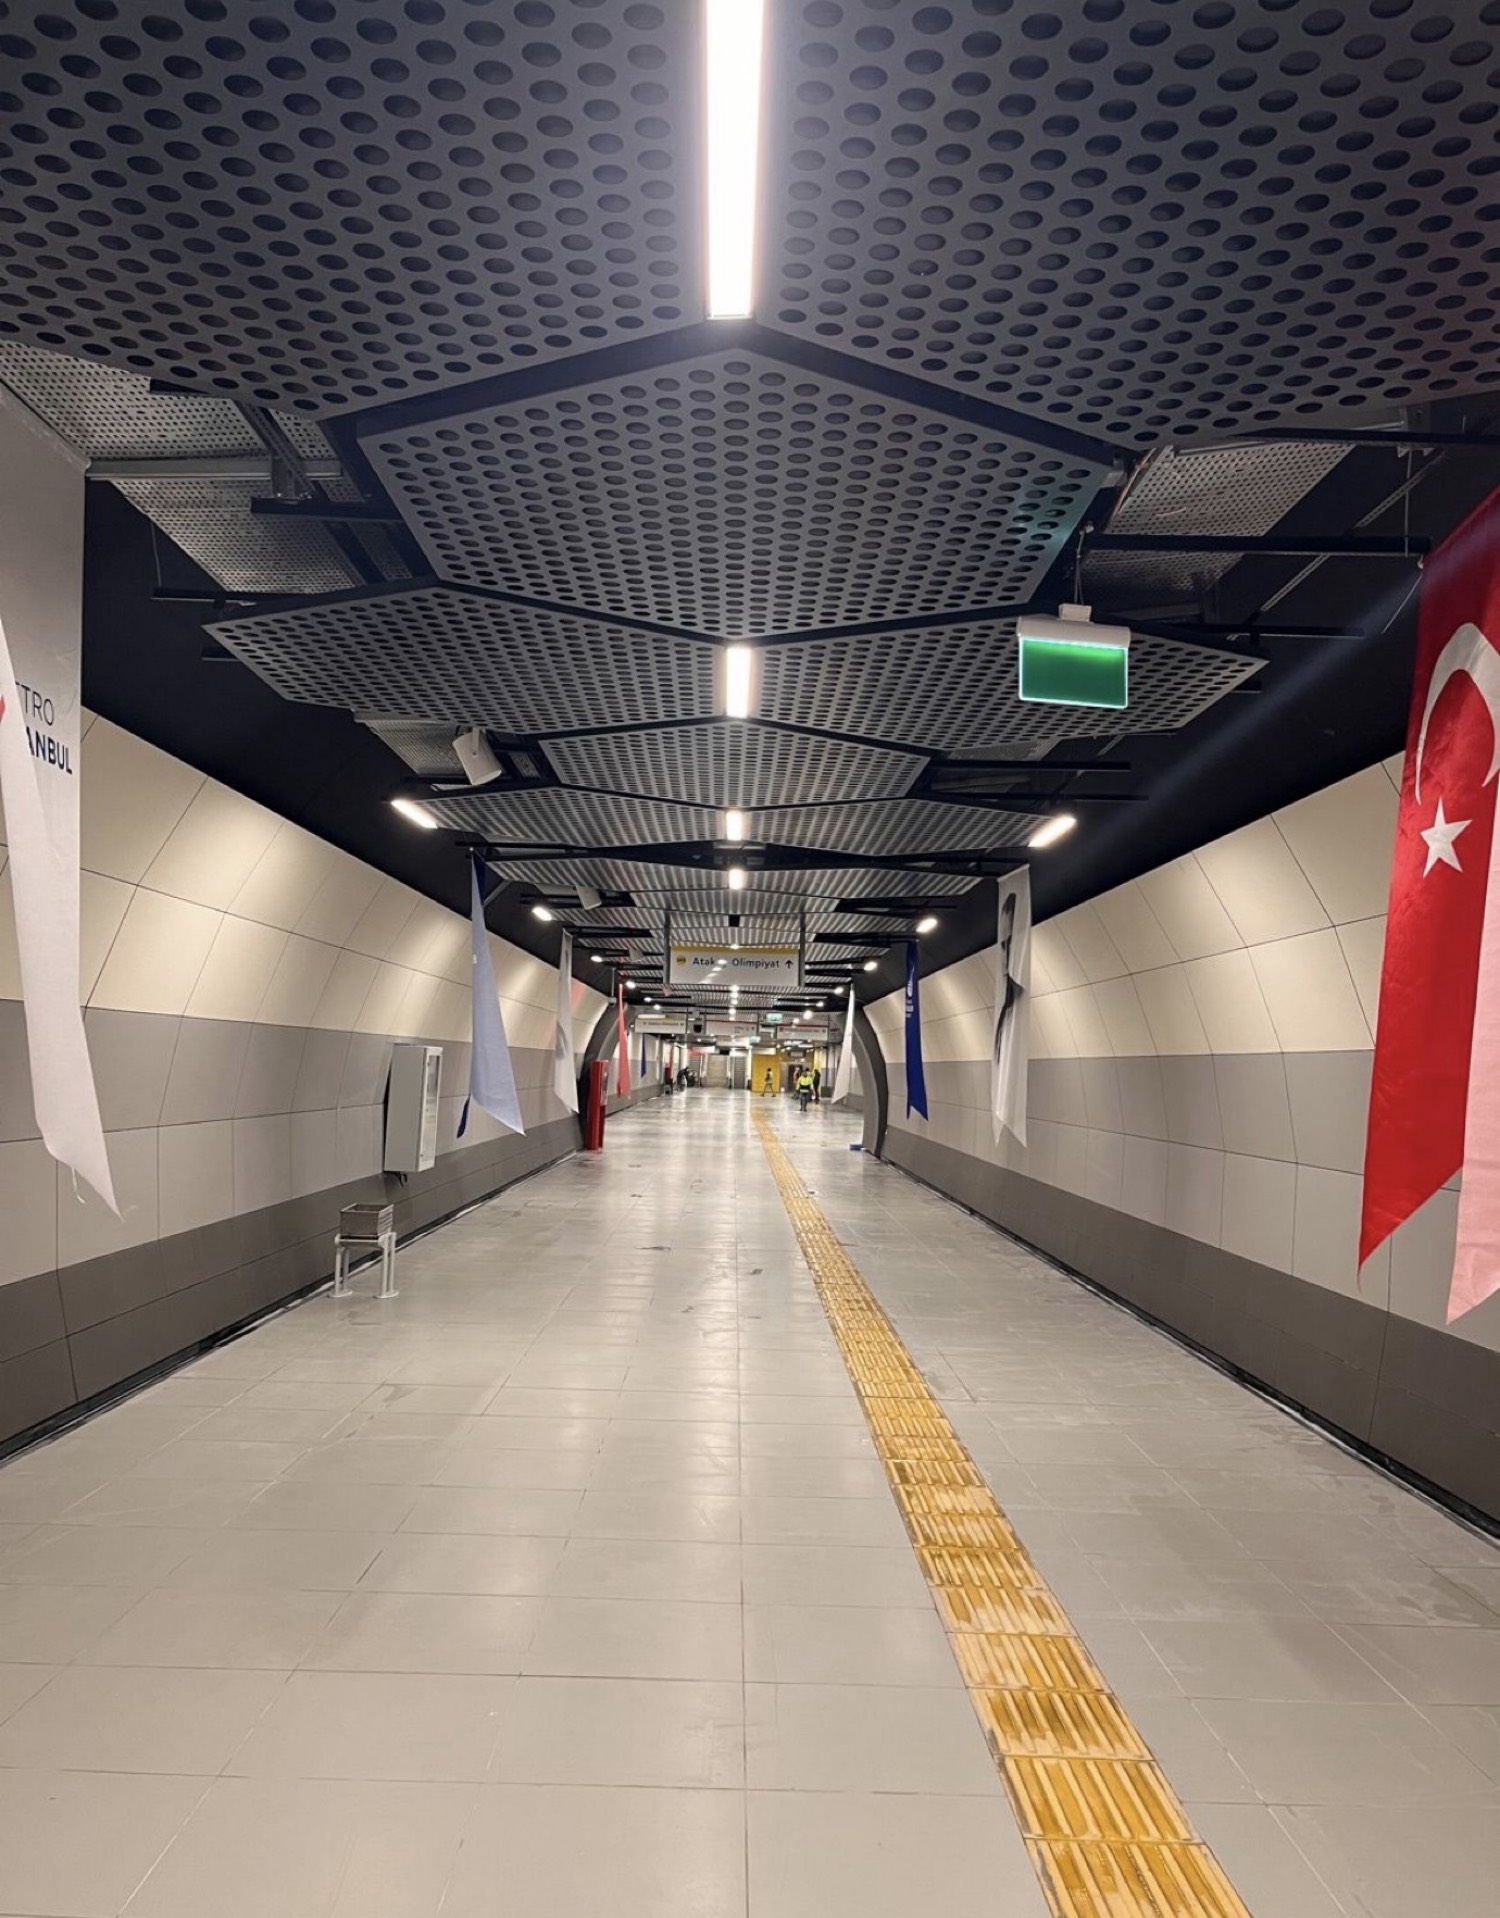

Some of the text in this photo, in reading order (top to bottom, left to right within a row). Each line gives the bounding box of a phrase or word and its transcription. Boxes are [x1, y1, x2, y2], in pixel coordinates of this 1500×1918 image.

[15, 682, 54, 726] TRO
[693, 957, 727, 969] Atak
[732, 957, 779, 969] Olimpiyat
